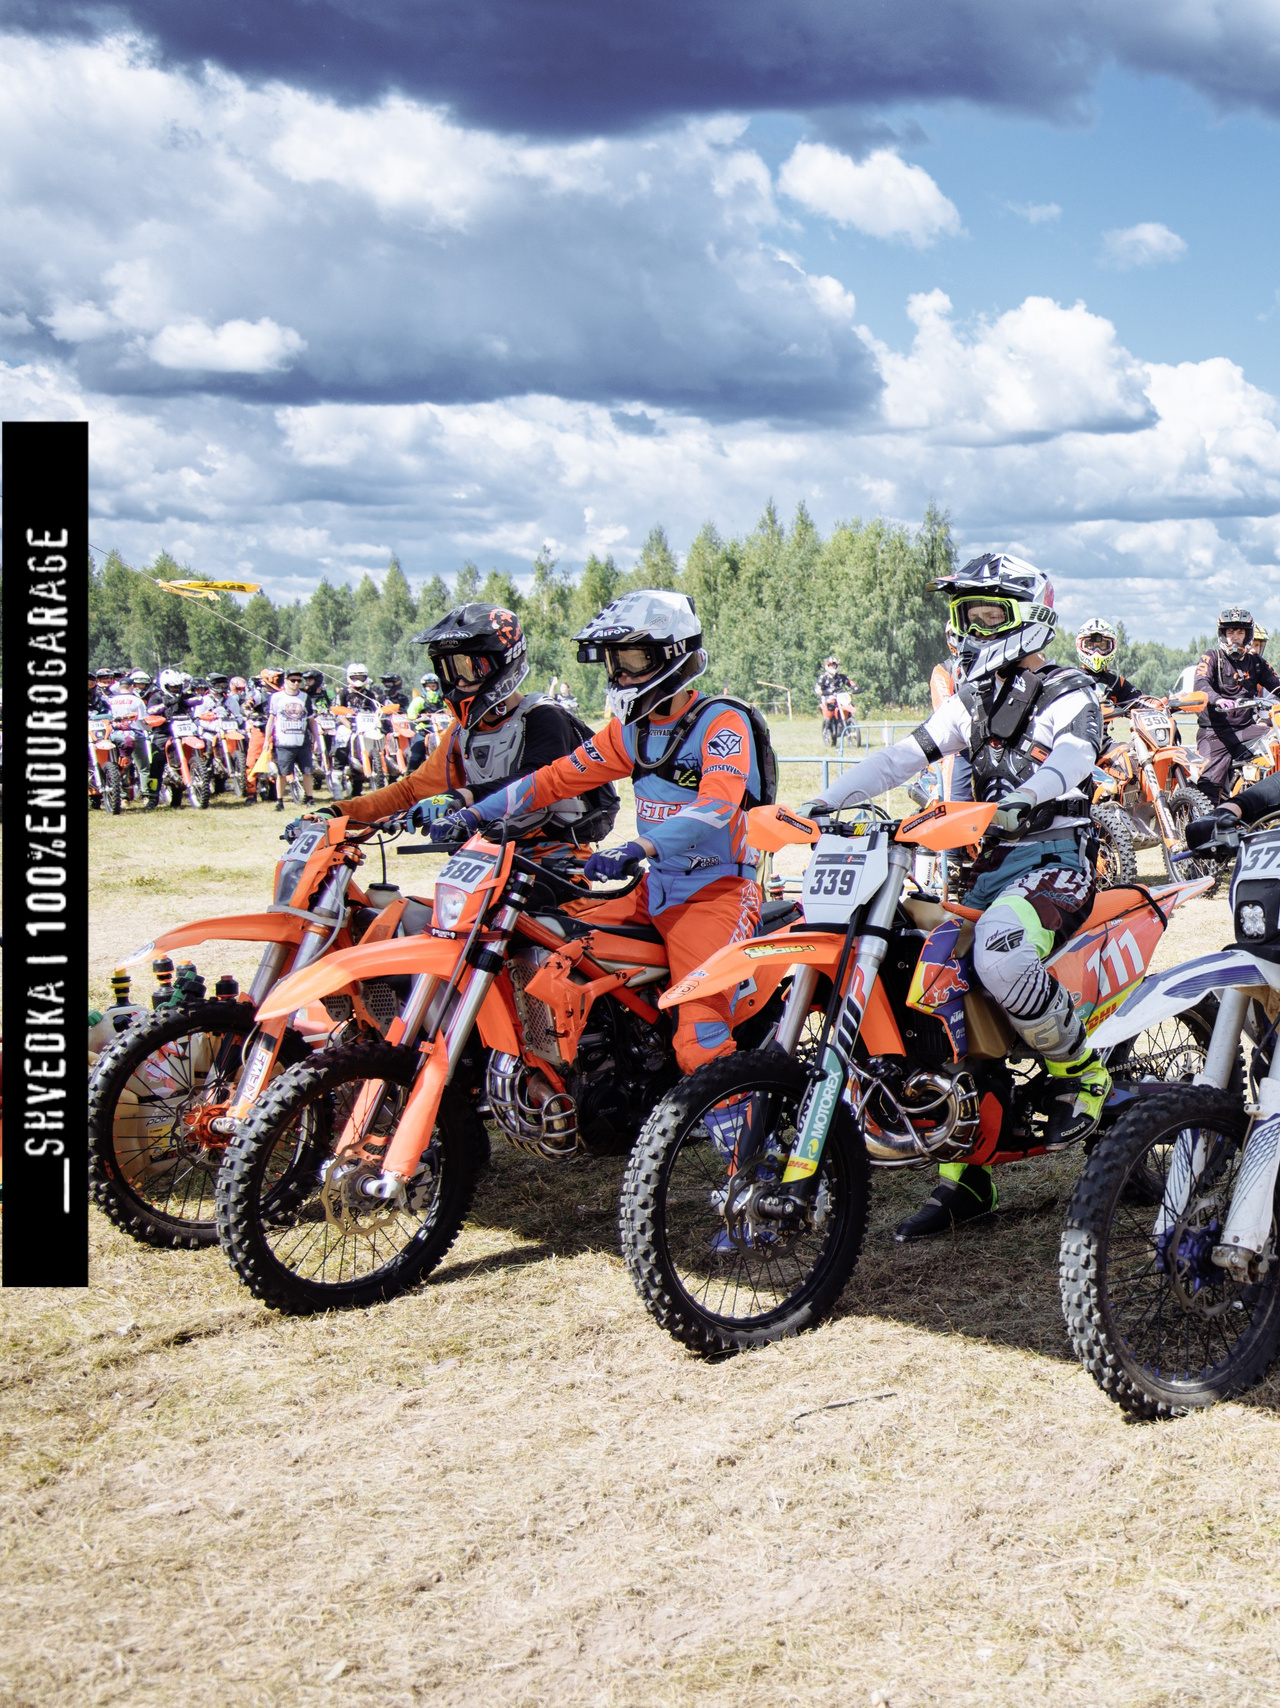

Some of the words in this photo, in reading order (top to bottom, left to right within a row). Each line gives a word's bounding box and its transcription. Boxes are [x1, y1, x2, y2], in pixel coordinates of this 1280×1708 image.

[592, 627, 631, 639] Airoh
[663, 640, 687, 660] FLY
[1144, 716, 1168, 727] 350
[440, 858, 486, 884] 380
[809, 868, 856, 896] 339
[1085, 928, 1145, 998] 111
[950, 1010, 964, 1024] KTM
[810, 1068, 842, 1139] MOTOREX
